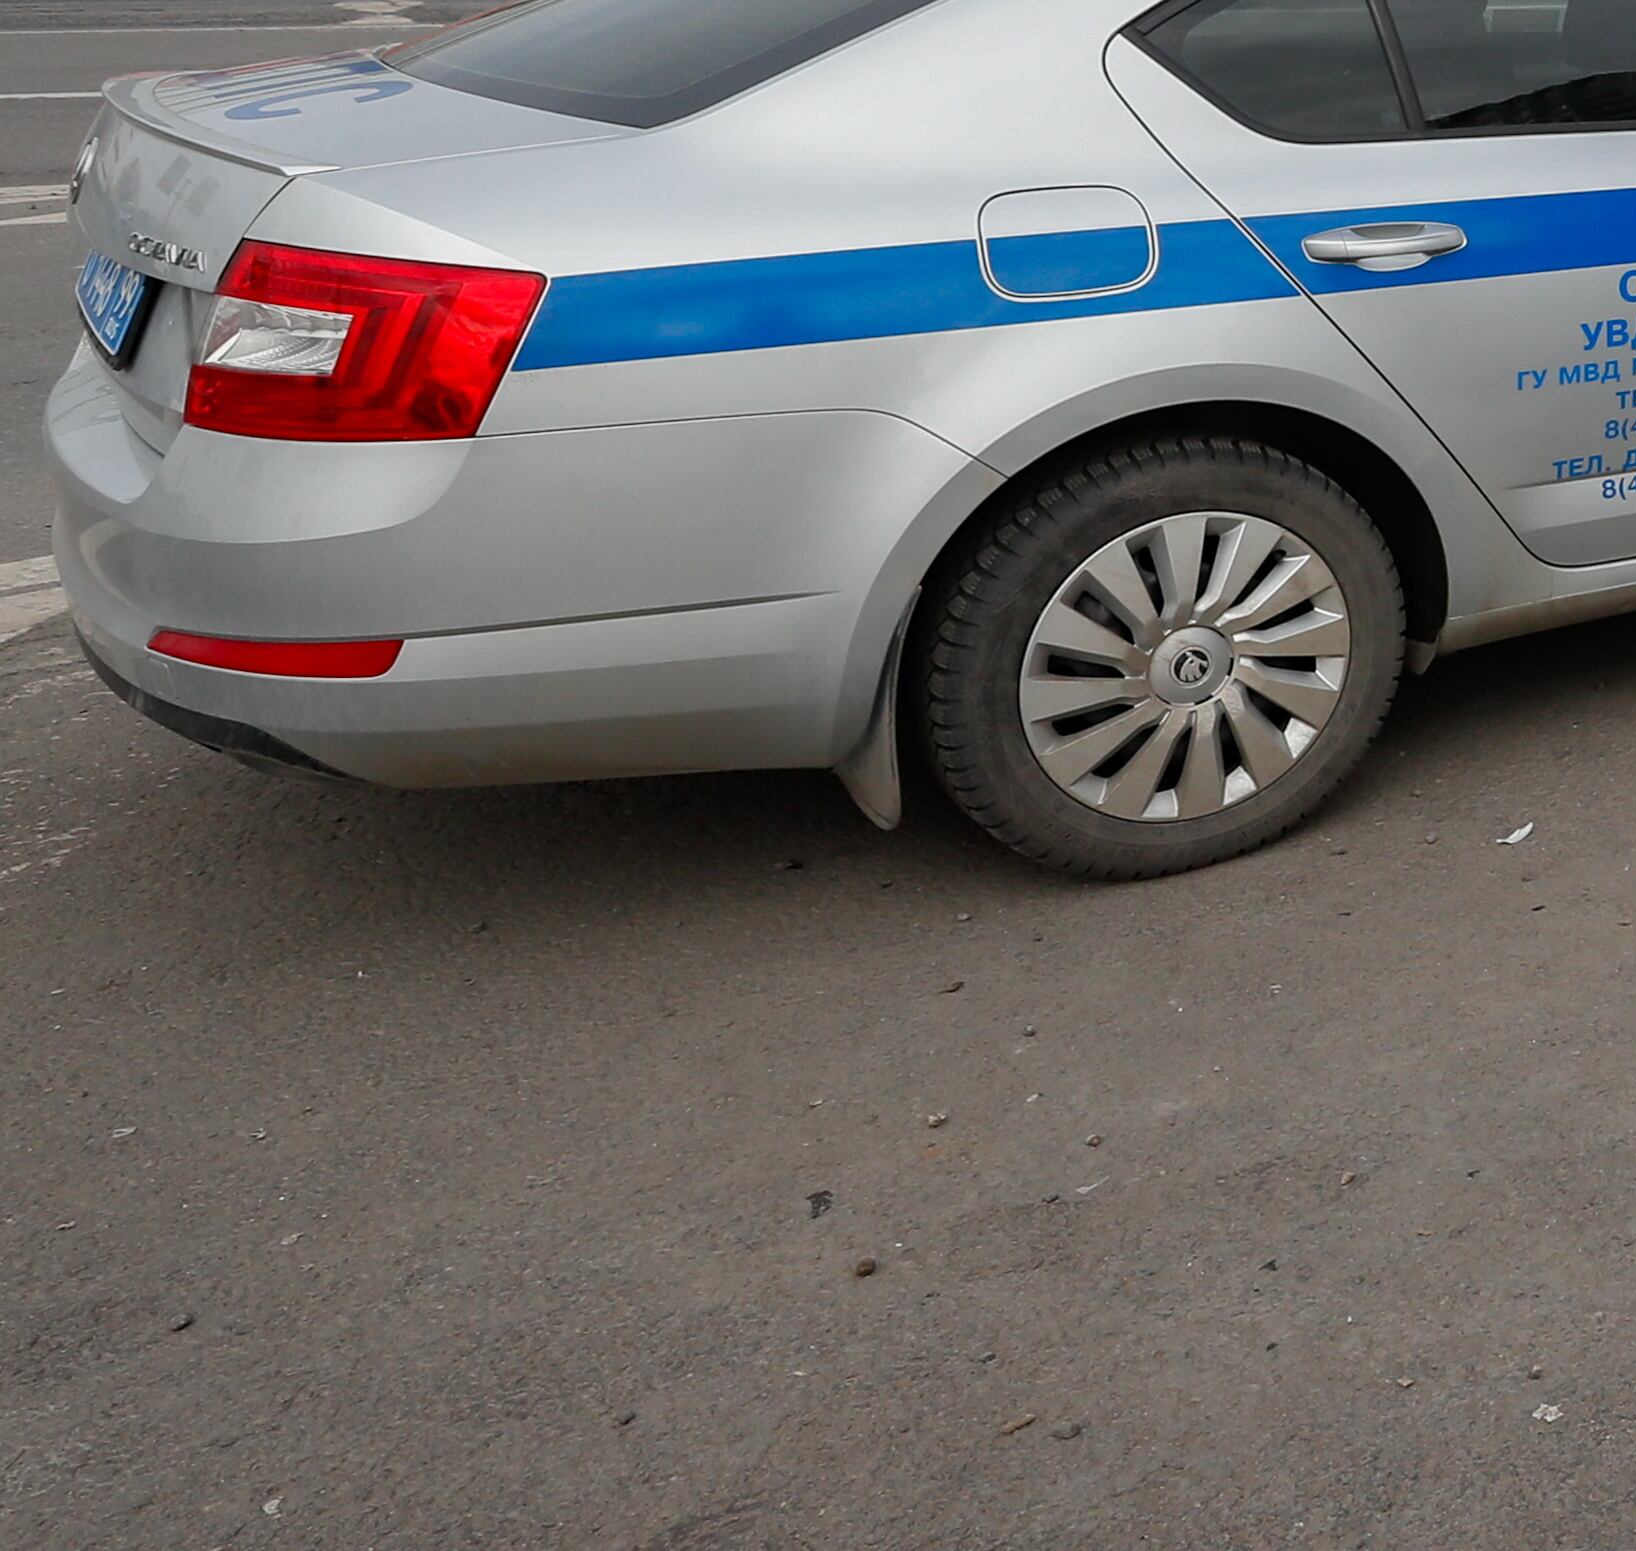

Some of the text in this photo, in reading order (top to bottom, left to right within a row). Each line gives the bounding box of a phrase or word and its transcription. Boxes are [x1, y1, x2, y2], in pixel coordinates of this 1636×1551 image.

[1516, 368, 1548, 391] ГУ
[1558, 360, 1620, 386] МВД
[1552, 454, 1611, 481] ТЕЛ.
